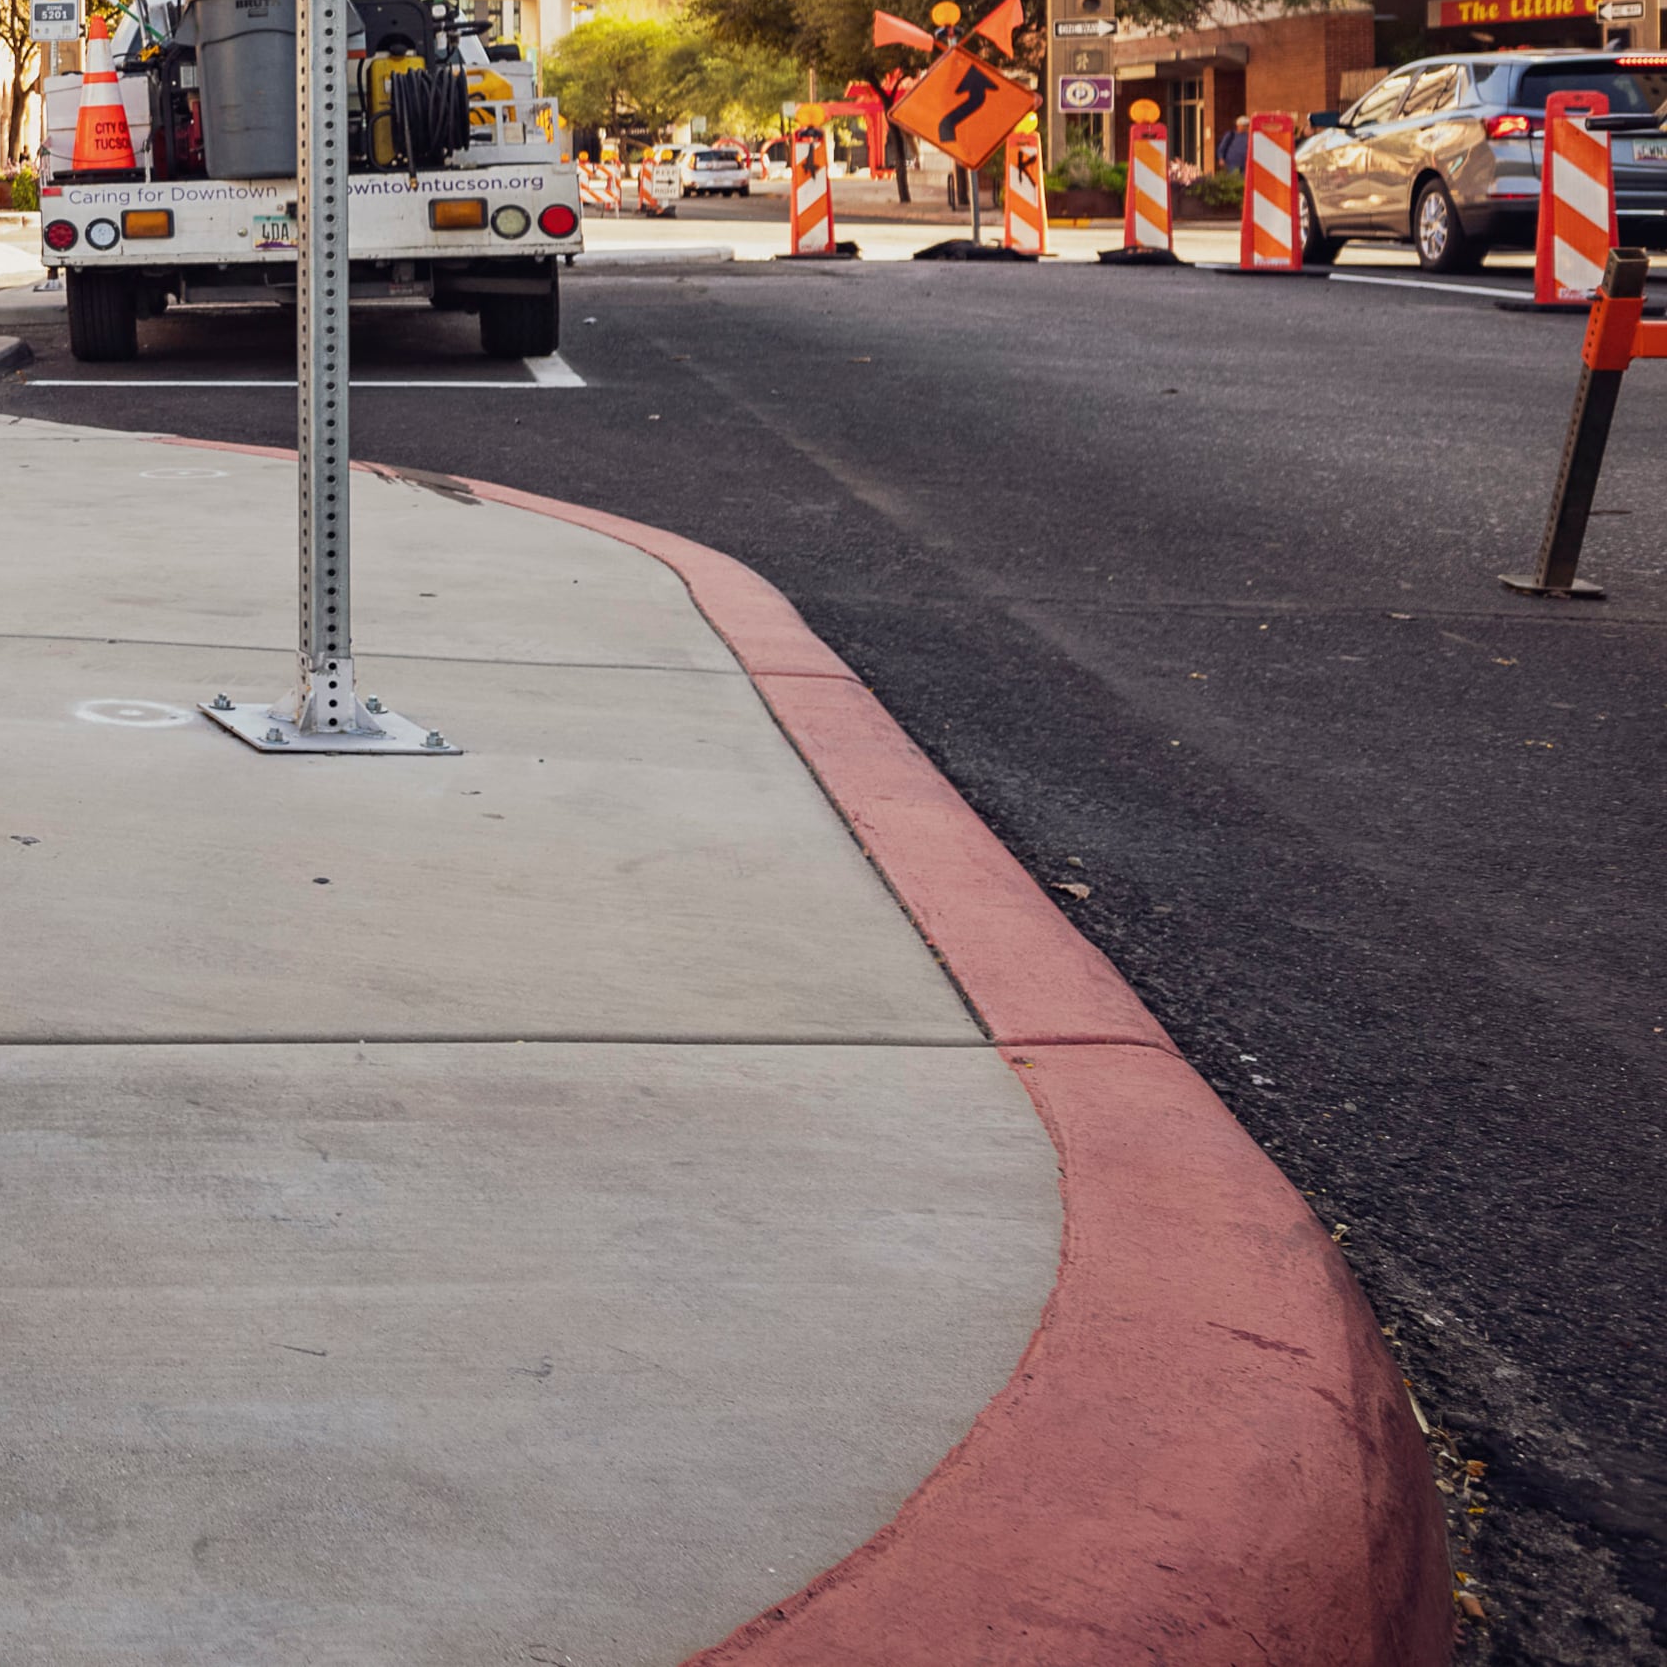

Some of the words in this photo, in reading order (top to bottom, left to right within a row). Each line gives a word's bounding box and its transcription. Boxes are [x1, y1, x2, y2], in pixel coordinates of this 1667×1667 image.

[41, 11, 68, 20] 5201
[1458, 0, 1500, 22] The
[95, 121, 116, 134] CITY
[69, 189, 131, 207] Caring
[137, 187, 165, 202] for
[171, 185, 278, 202] Downtown
[347, 175, 544, 196] owntowntucson.org
